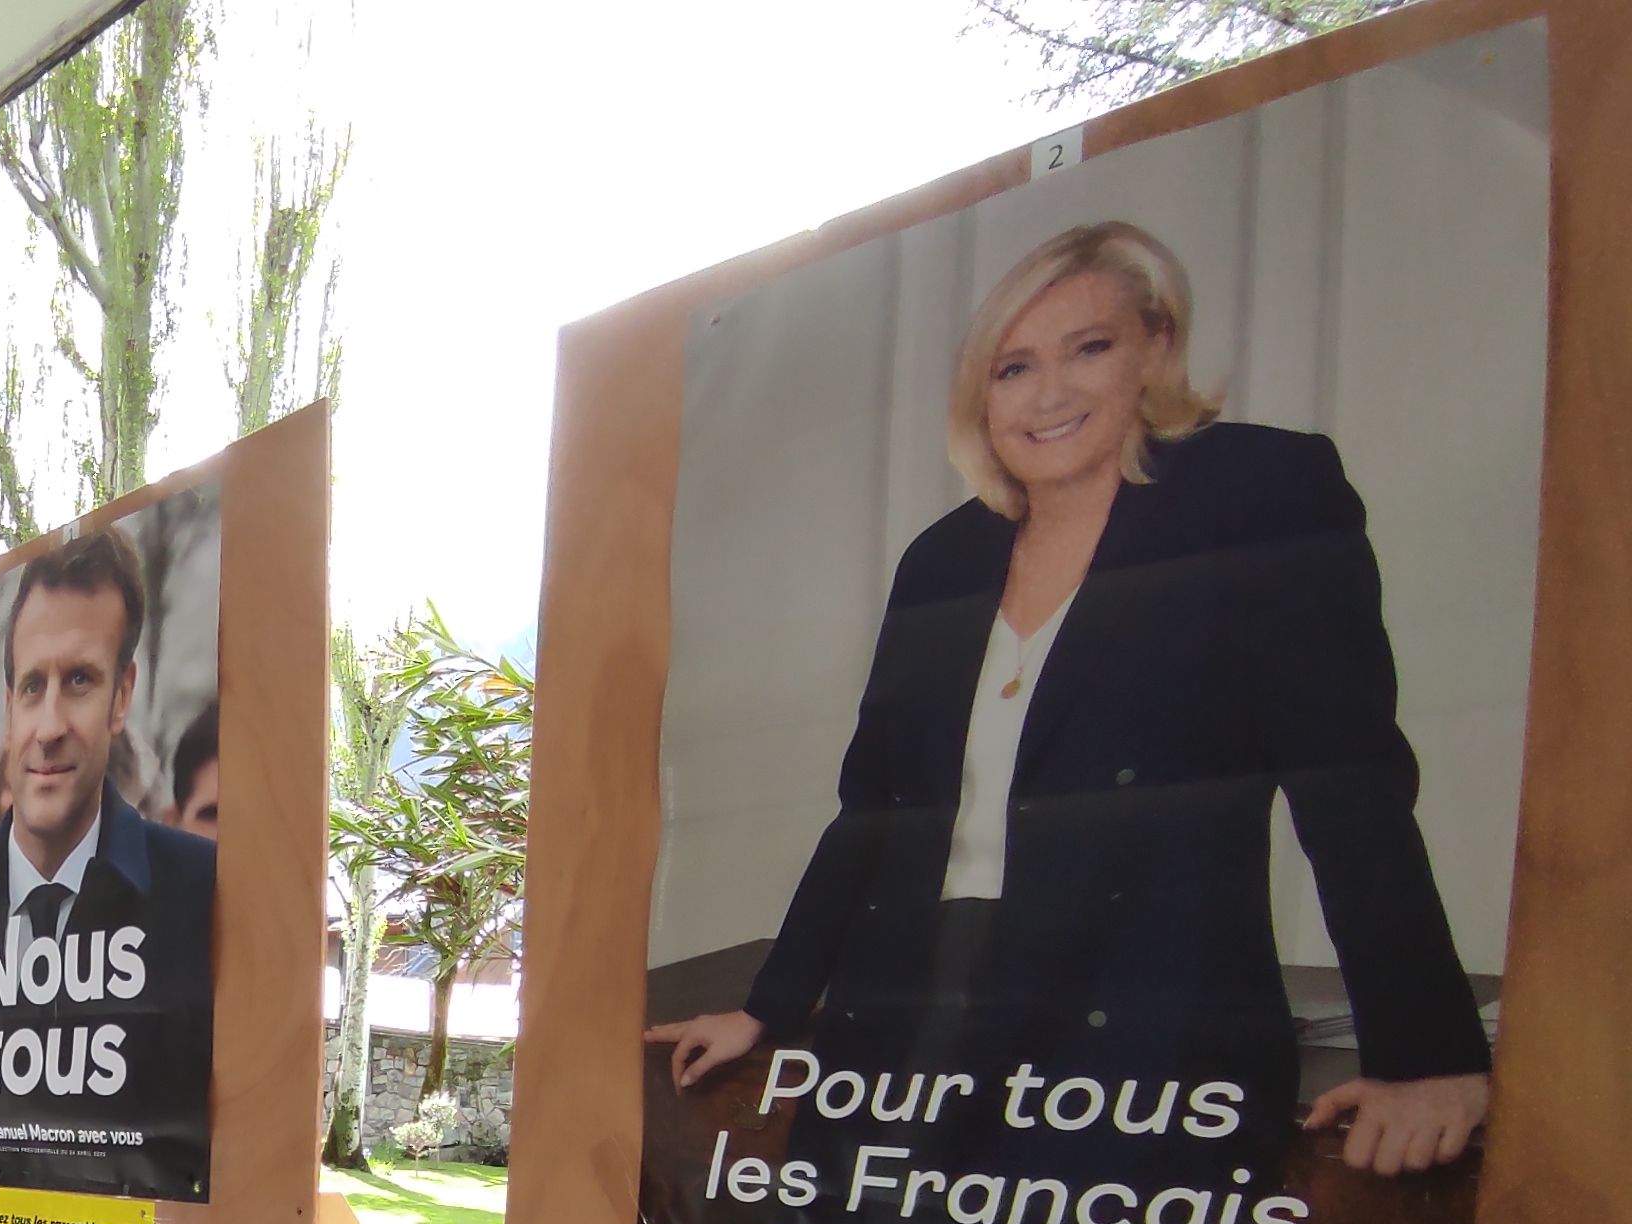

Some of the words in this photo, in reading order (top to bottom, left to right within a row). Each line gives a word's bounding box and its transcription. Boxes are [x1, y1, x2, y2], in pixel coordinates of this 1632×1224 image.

[1048, 144, 1064, 170] 2
[758, 1049, 973, 1124] Pour
[1003, 1063, 1245, 1138] tous
[28, 1123, 75, 1143] Macron
[78, 1129, 107, 1144] avec
[110, 1130, 144, 1146] vous
[705, 1130, 817, 1207] les
